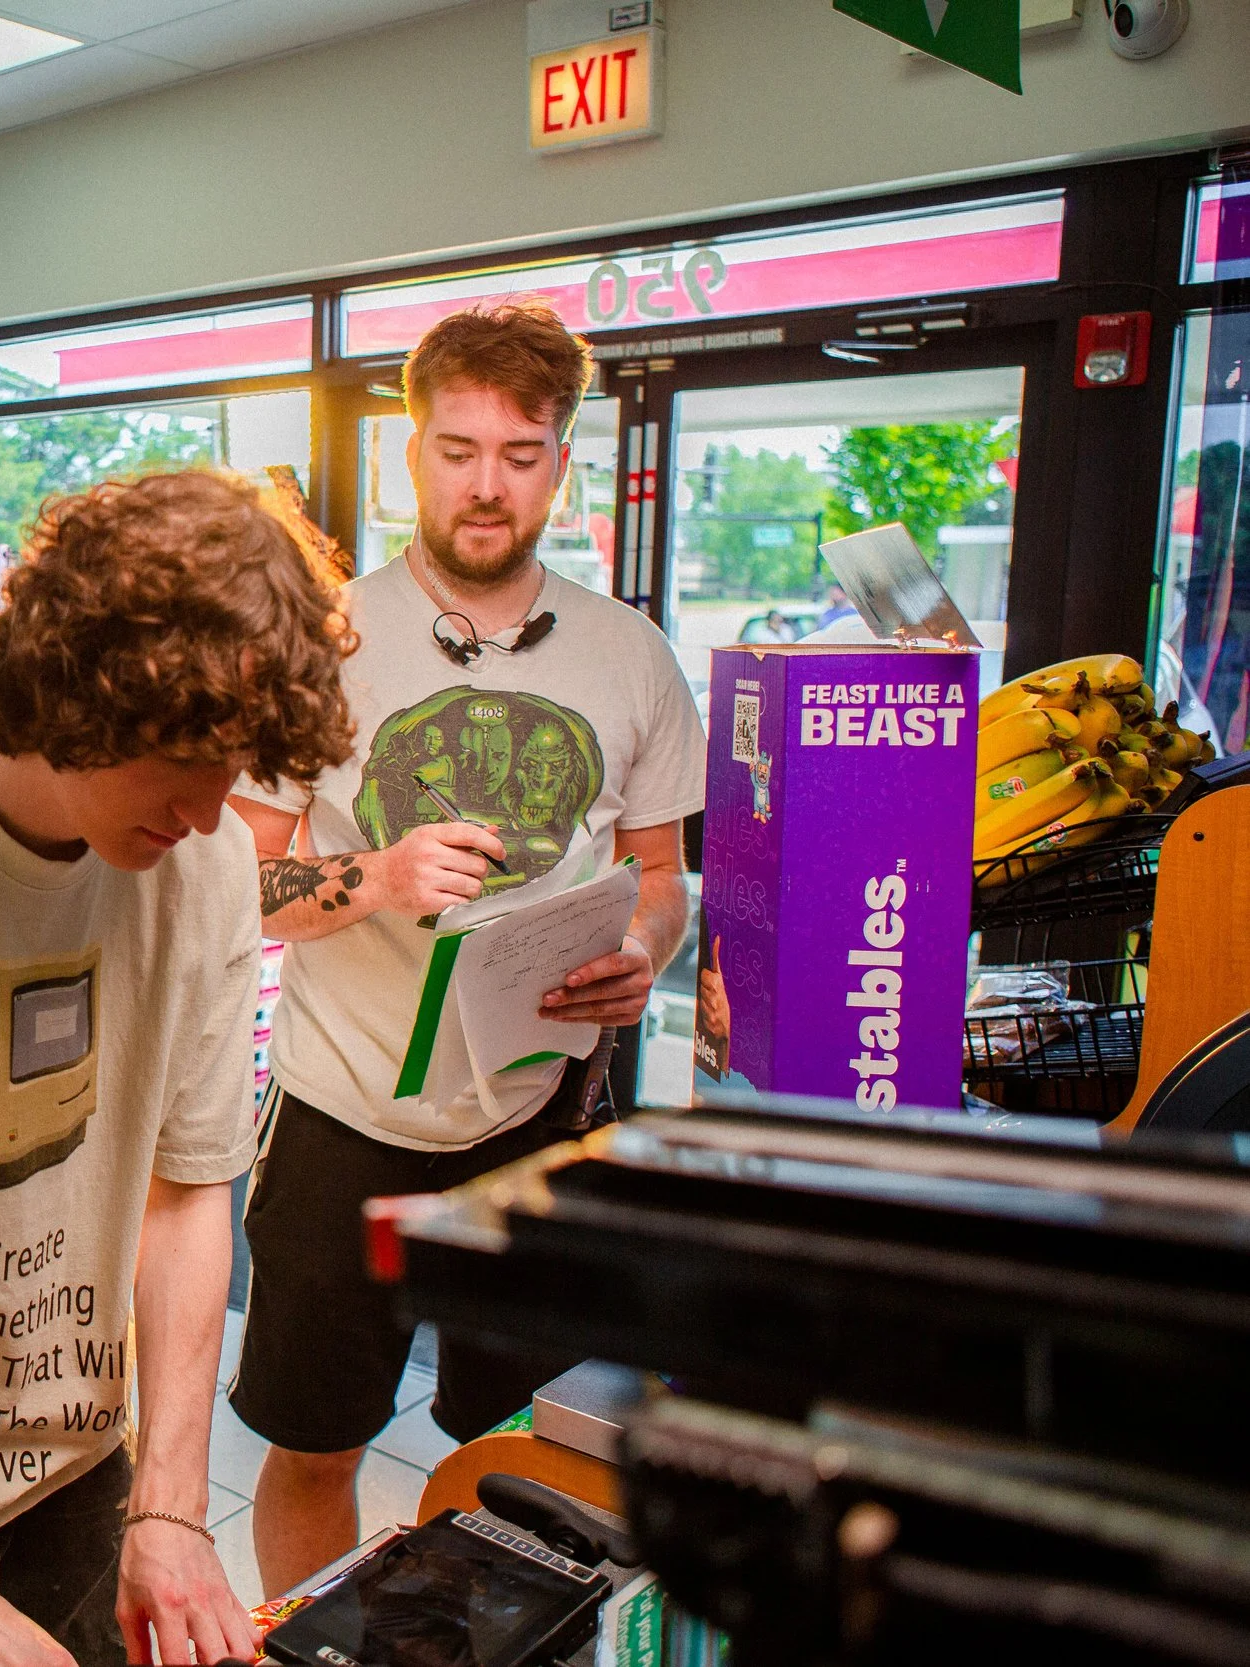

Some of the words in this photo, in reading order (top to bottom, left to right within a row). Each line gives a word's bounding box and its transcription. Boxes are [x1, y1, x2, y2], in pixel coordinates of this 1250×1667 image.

[543, 48, 637, 134] EXIT
[470, 705, 505, 720] 1408
[802, 684, 882, 706] FEAST
[884, 684, 940, 705] LIKE
[943, 684, 965, 705] A
[800, 707, 966, 747] BEAST
[845, 873, 908, 1114] stables
[2, 1344, 63, 1389] That
[75, 1338, 124, 1380] Wil
[62, 1401, 127, 1432] Wor
[640, 1583, 657, 1616] Put
[635, 1614, 652, 1651] your
